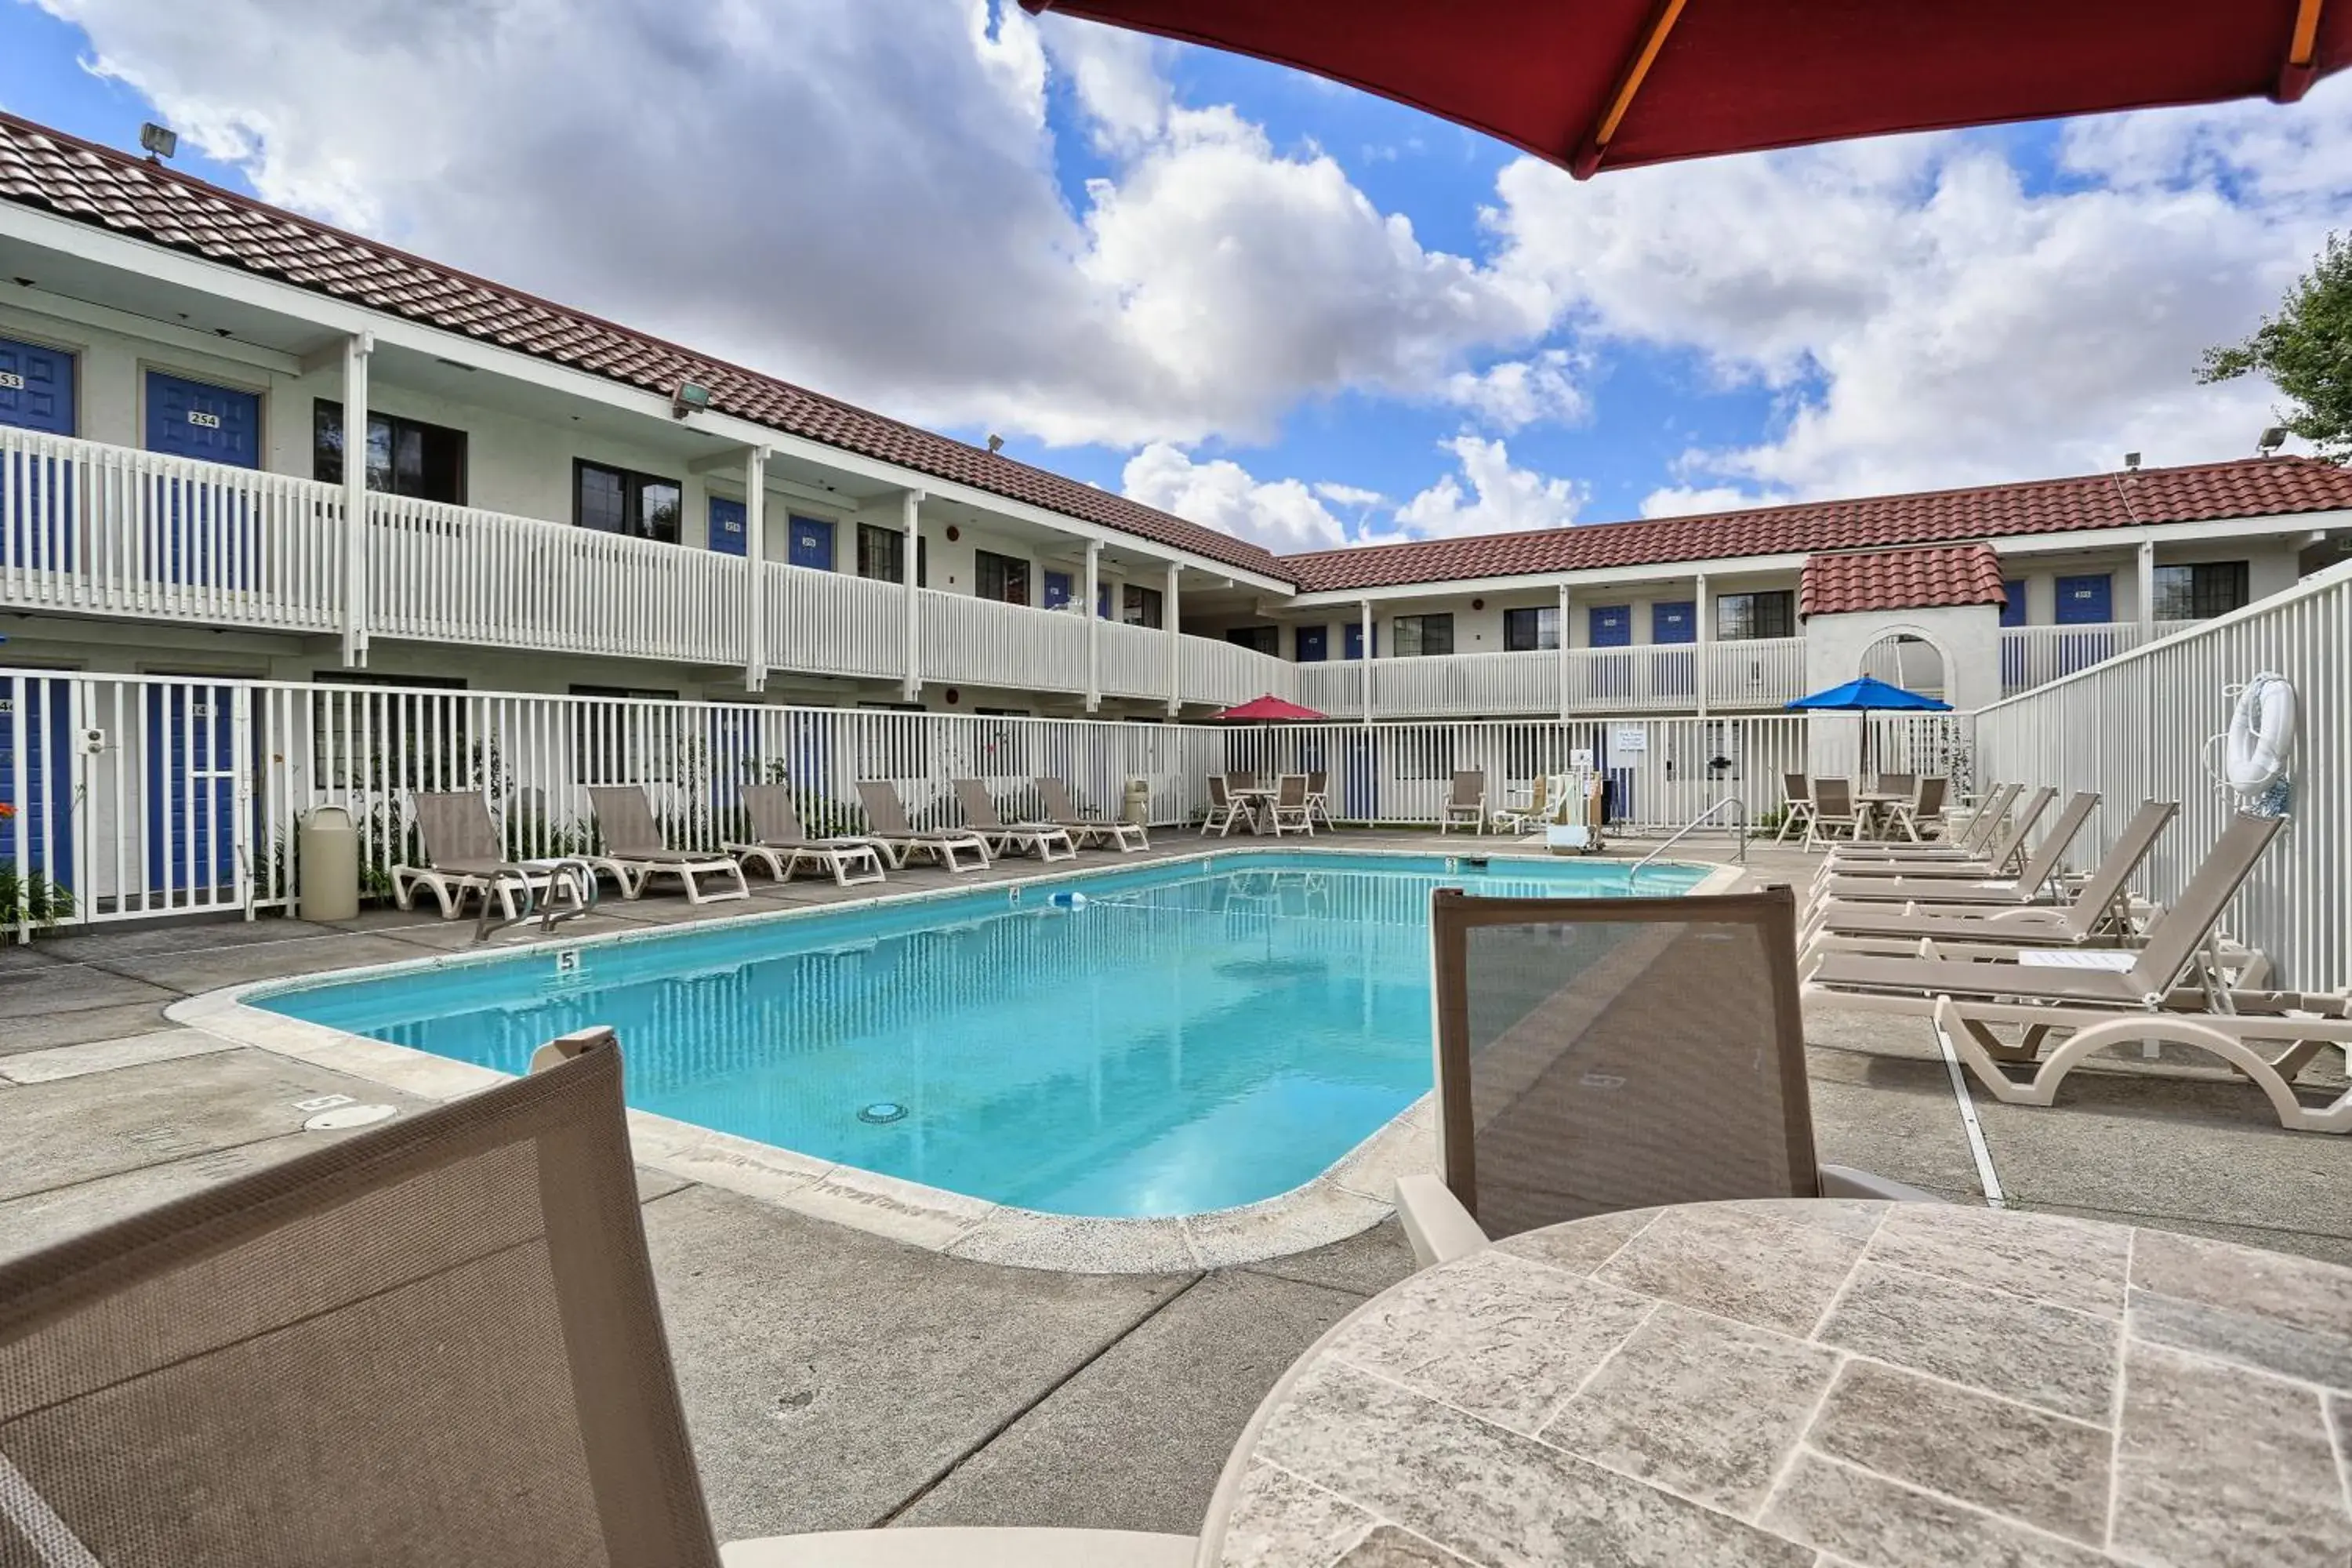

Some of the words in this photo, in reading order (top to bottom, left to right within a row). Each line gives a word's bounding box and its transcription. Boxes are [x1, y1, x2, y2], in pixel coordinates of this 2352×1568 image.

[0, 374, 20, 387] 53
[191, 412, 216, 426] 254
[561, 951, 574, 971] 5
